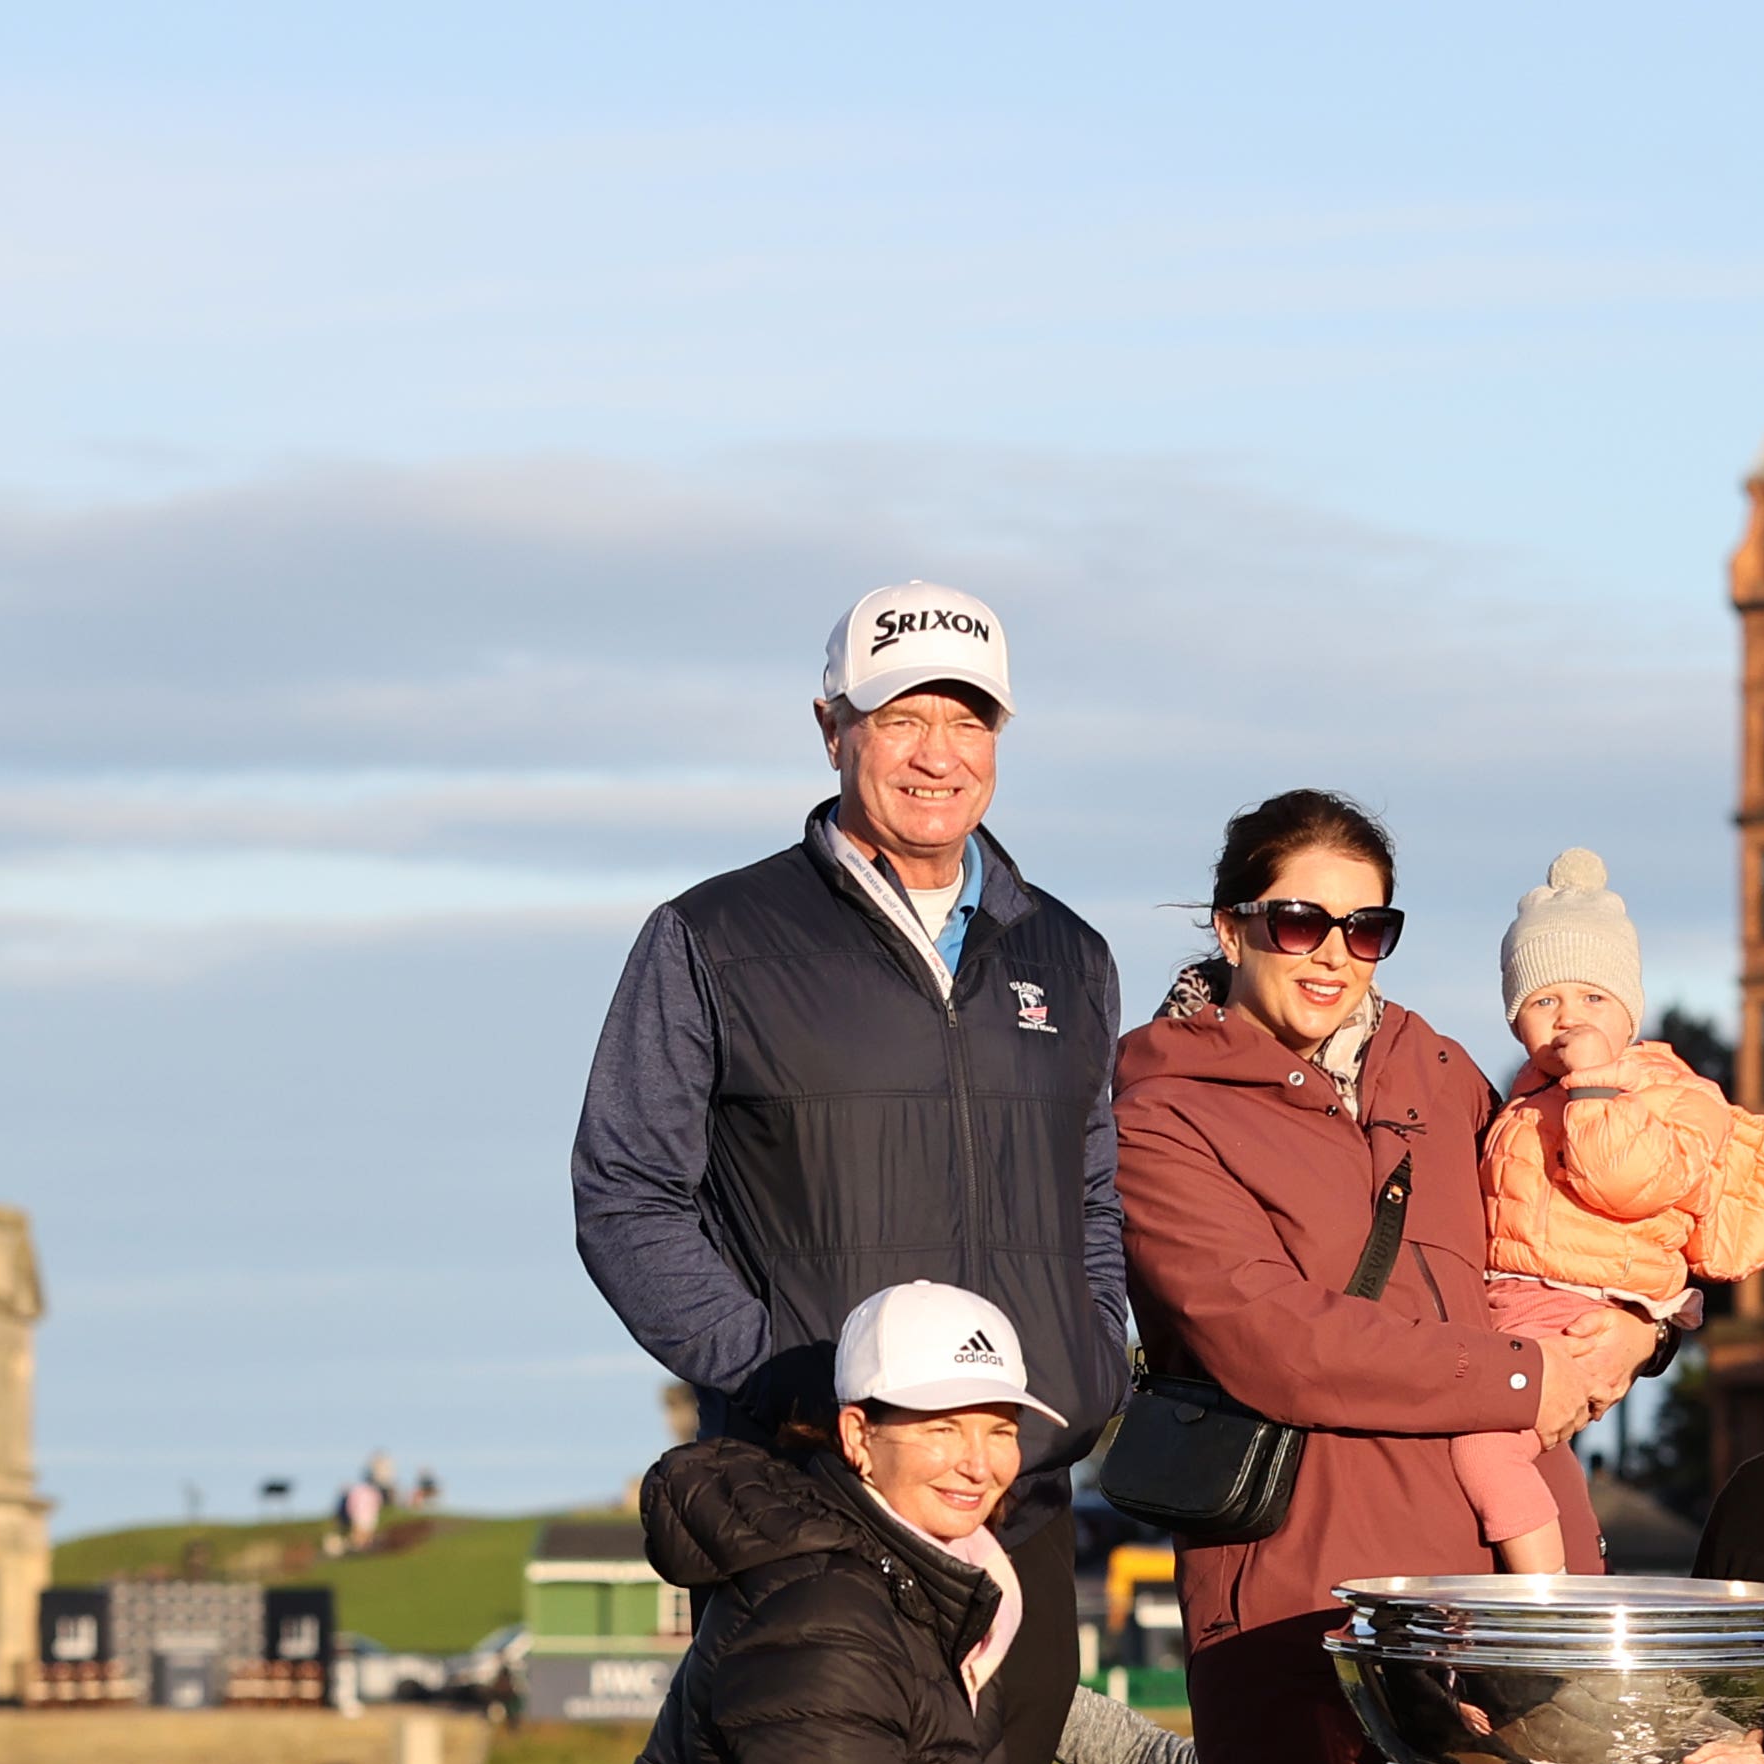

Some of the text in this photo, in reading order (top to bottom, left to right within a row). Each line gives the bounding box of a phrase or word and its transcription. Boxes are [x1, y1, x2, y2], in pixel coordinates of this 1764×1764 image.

[871, 610, 989, 656] SRIXON
[846, 851, 866, 873] United
[863, 870, 884, 895] States
[882, 891, 898, 910] Golf
[954, 1350, 1004, 1367] adidas
